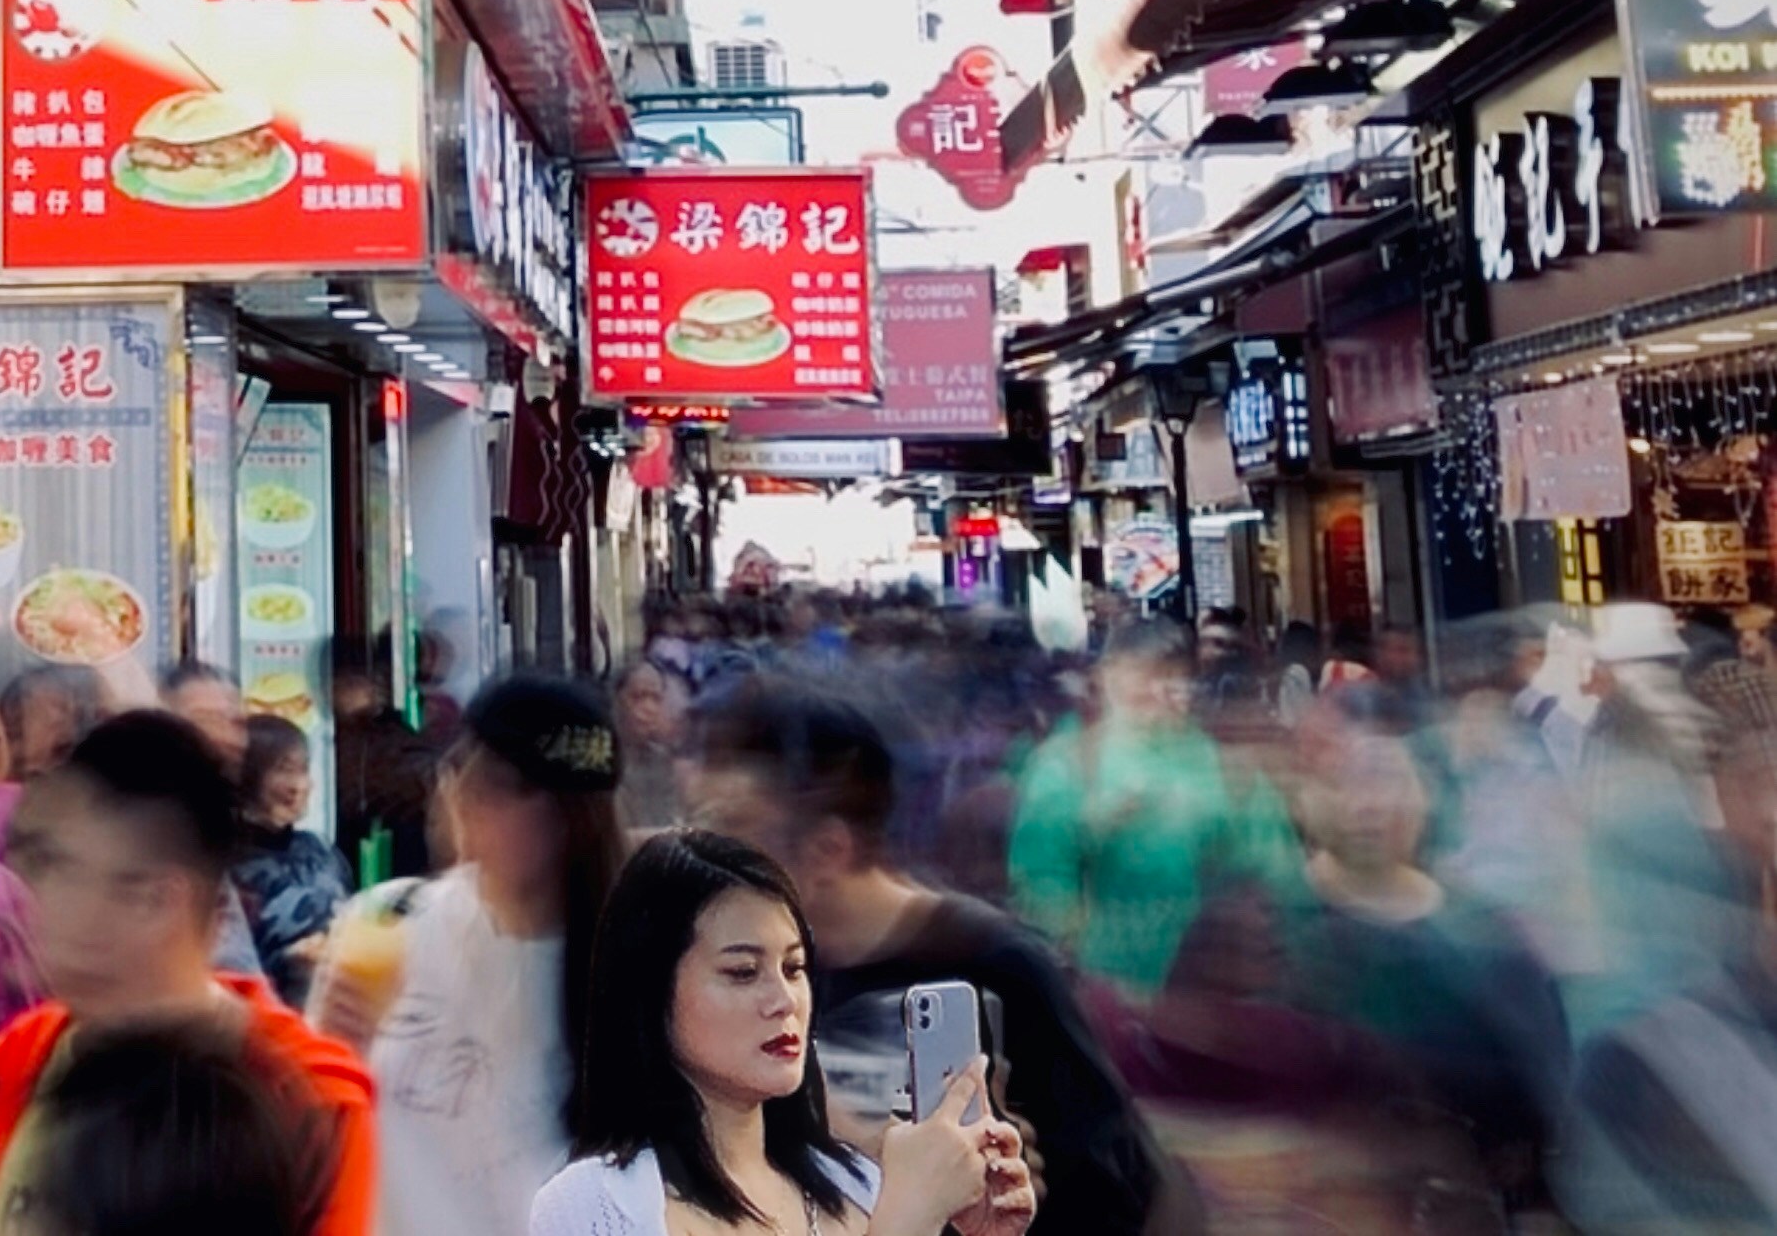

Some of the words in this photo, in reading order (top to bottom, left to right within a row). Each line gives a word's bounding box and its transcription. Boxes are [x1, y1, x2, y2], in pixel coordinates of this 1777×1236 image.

[1688, 42, 1750, 71] KOI
[669, 200, 860, 255] 梁錦記
